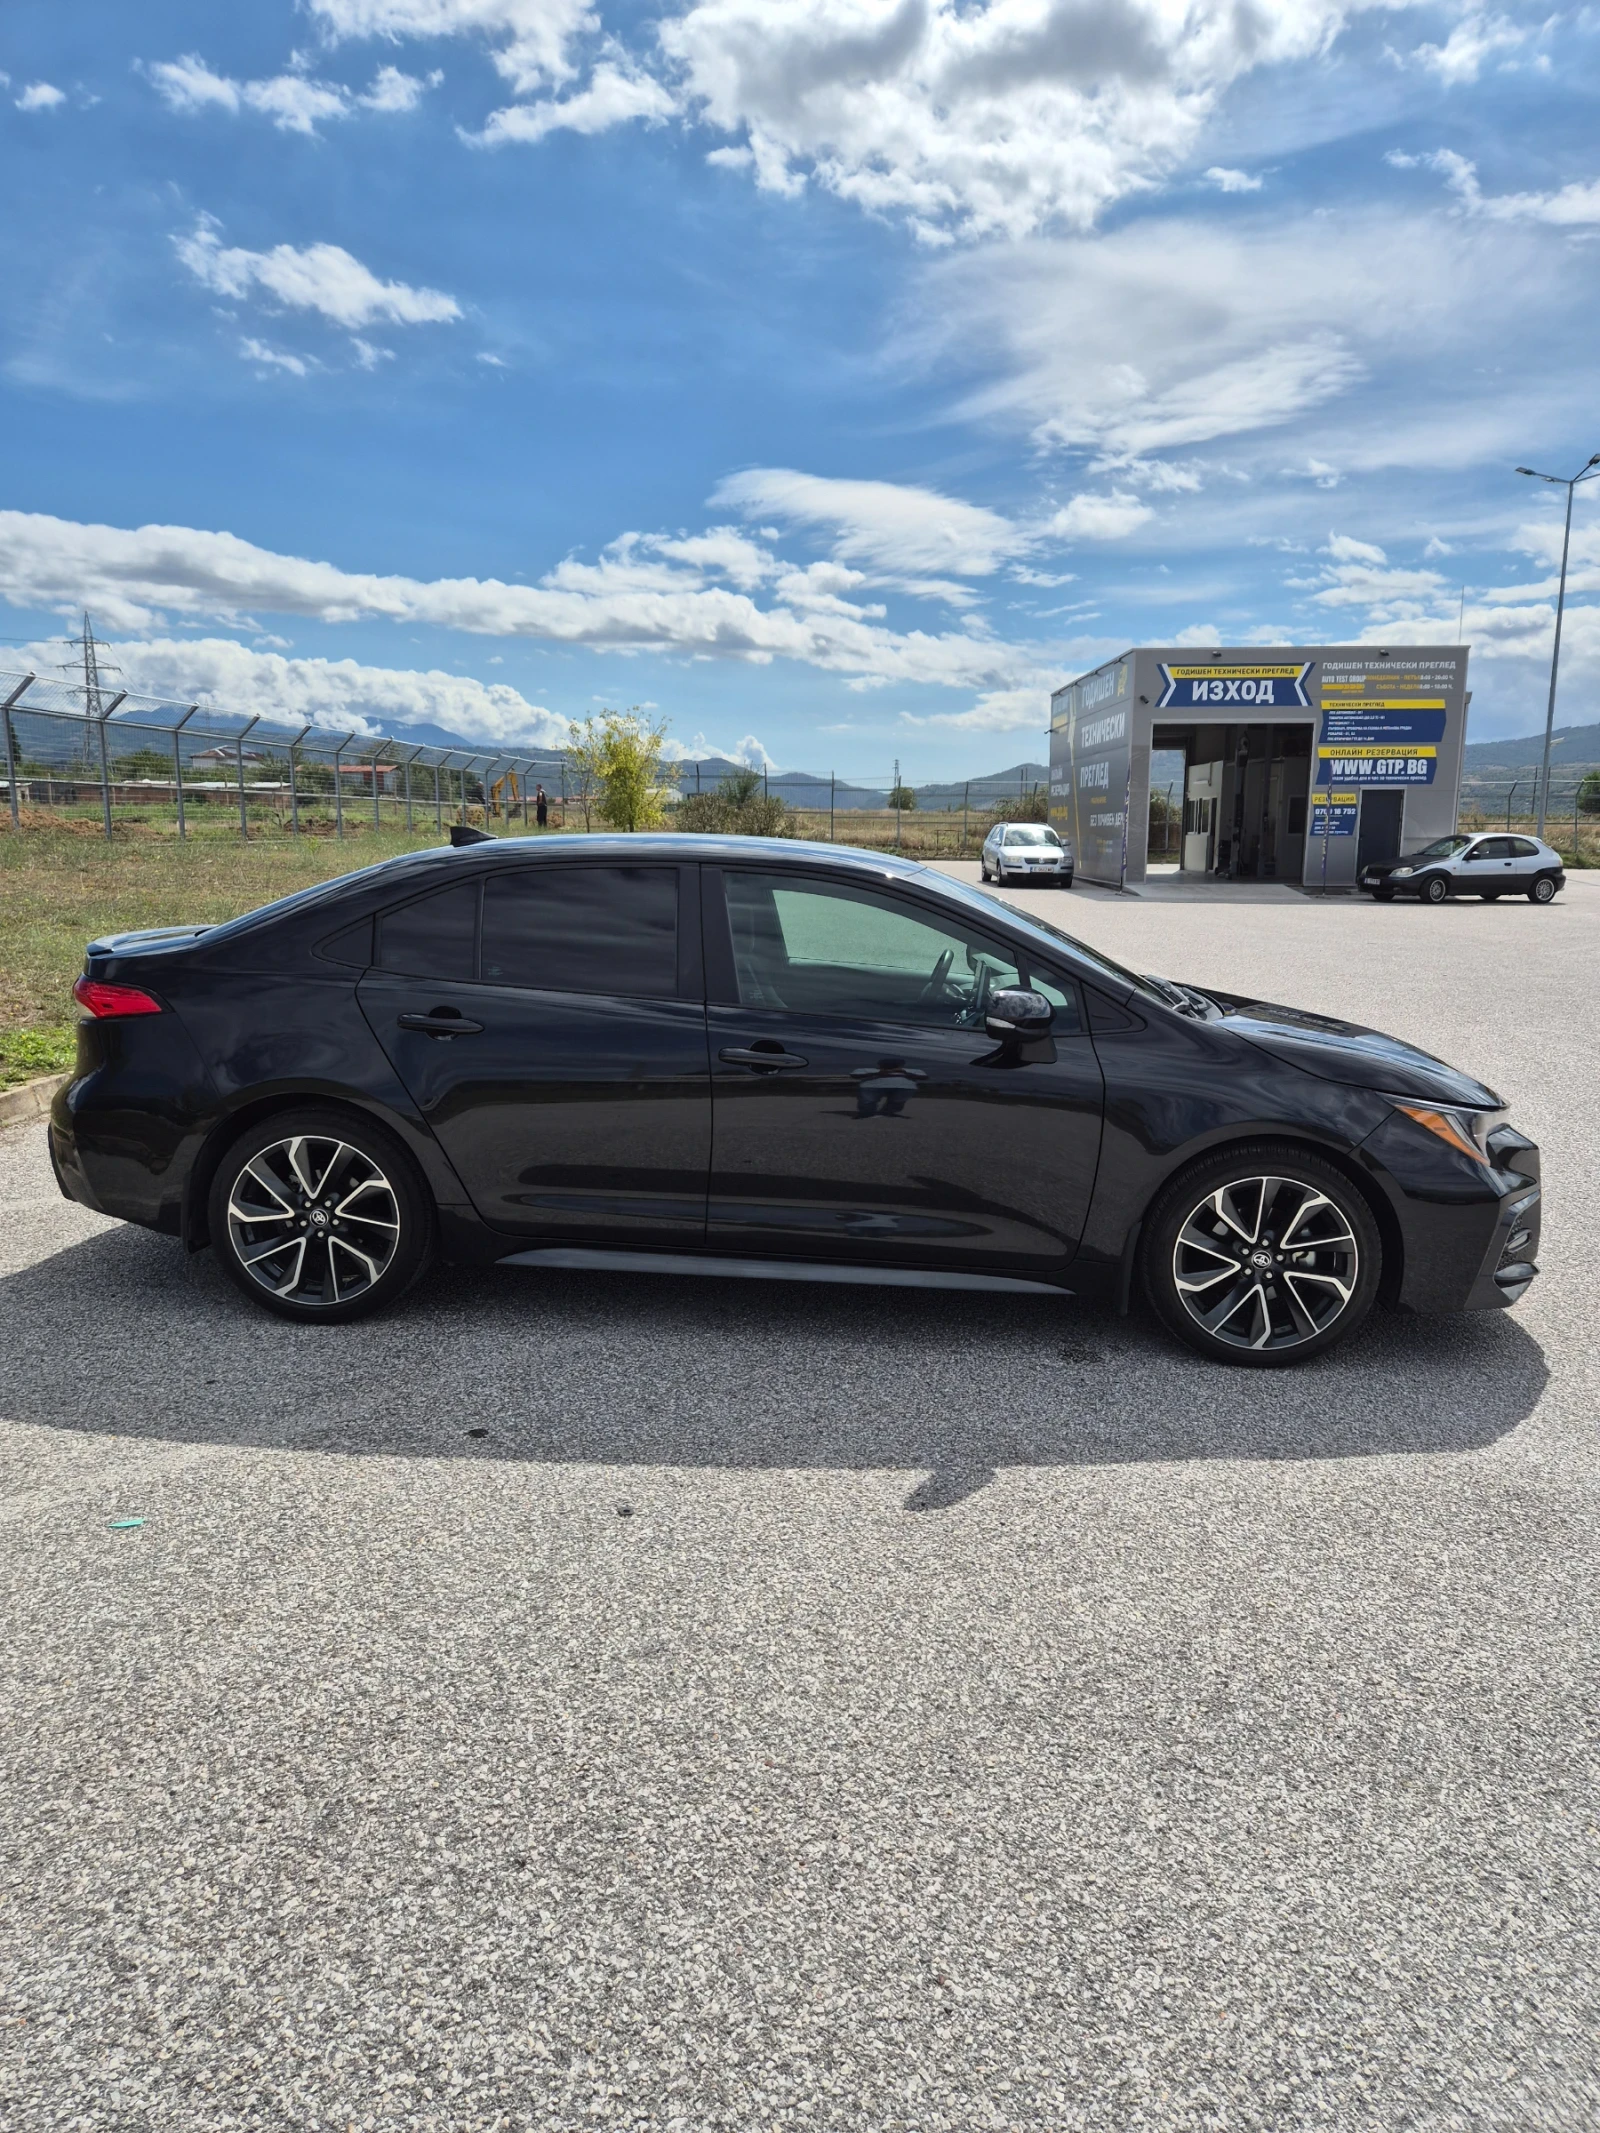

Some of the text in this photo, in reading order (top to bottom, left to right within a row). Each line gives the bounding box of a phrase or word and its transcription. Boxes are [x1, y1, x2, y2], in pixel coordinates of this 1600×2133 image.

[1176, 667, 1295, 676] ГОДИШЕН ТЕХНИЧЕСКИ ПРЕГЛЕД
[1322, 661, 1456, 670] ГОДИШЕН ТЕХНИЧЕСКИ ПРЕГЛЕД
[1336, 675, 1348, 684] TEST
[1081, 671, 1115, 709] ГОДИШЕН
[1192, 680, 1275, 704] ИЗХОД
[1081, 712, 1126, 748] ТЕХНИЧЕСКИ
[1330, 748, 1418, 757] ОНЛАЙН РЕЗЕРВАЦИЯ
[1080, 761, 1109, 789] ПРЕГЛЕД
[1331, 759, 1428, 775] WWW.GTP.BG
